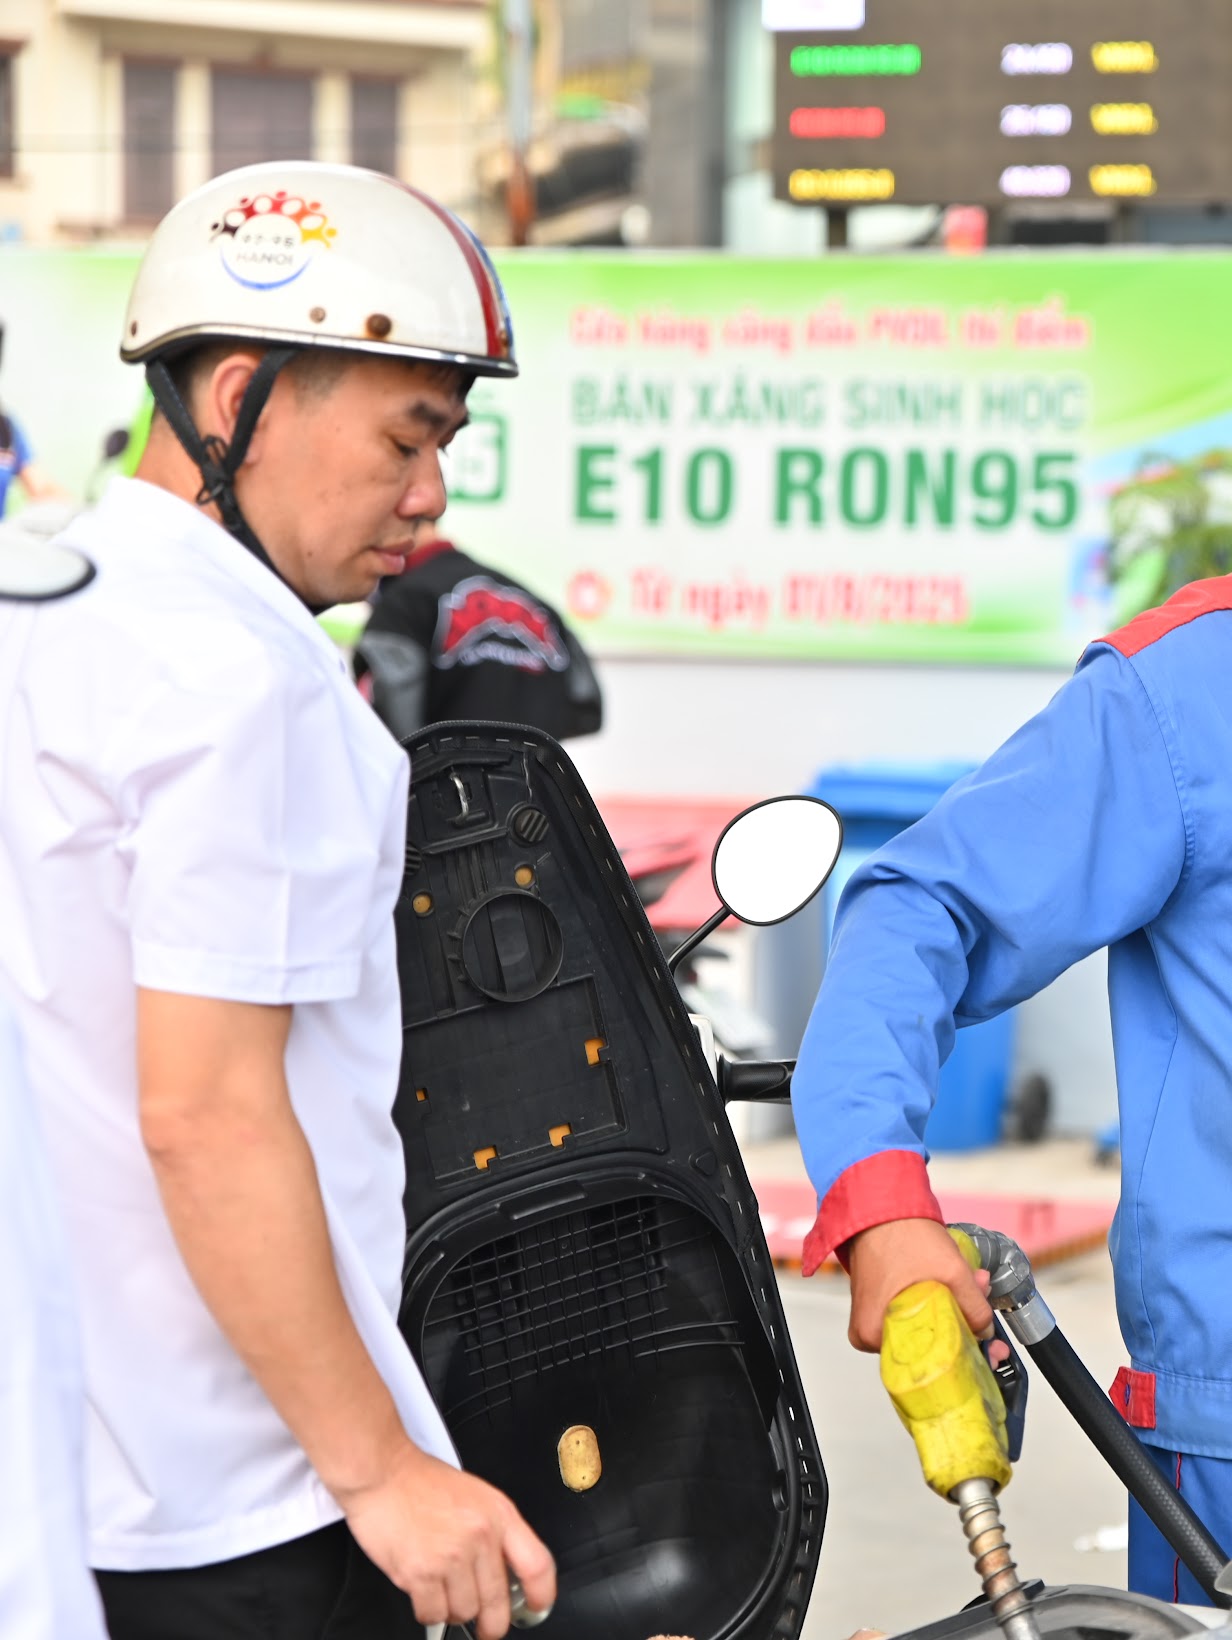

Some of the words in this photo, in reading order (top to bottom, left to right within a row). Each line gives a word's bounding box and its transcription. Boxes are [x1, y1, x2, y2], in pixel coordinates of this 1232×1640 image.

[572, 366, 671, 426] BÁN
[843, 378, 962, 427] SINH
[981, 378, 1087, 434] HỌC
[574, 445, 735, 527] E10
[775, 447, 1080, 532] RON95
